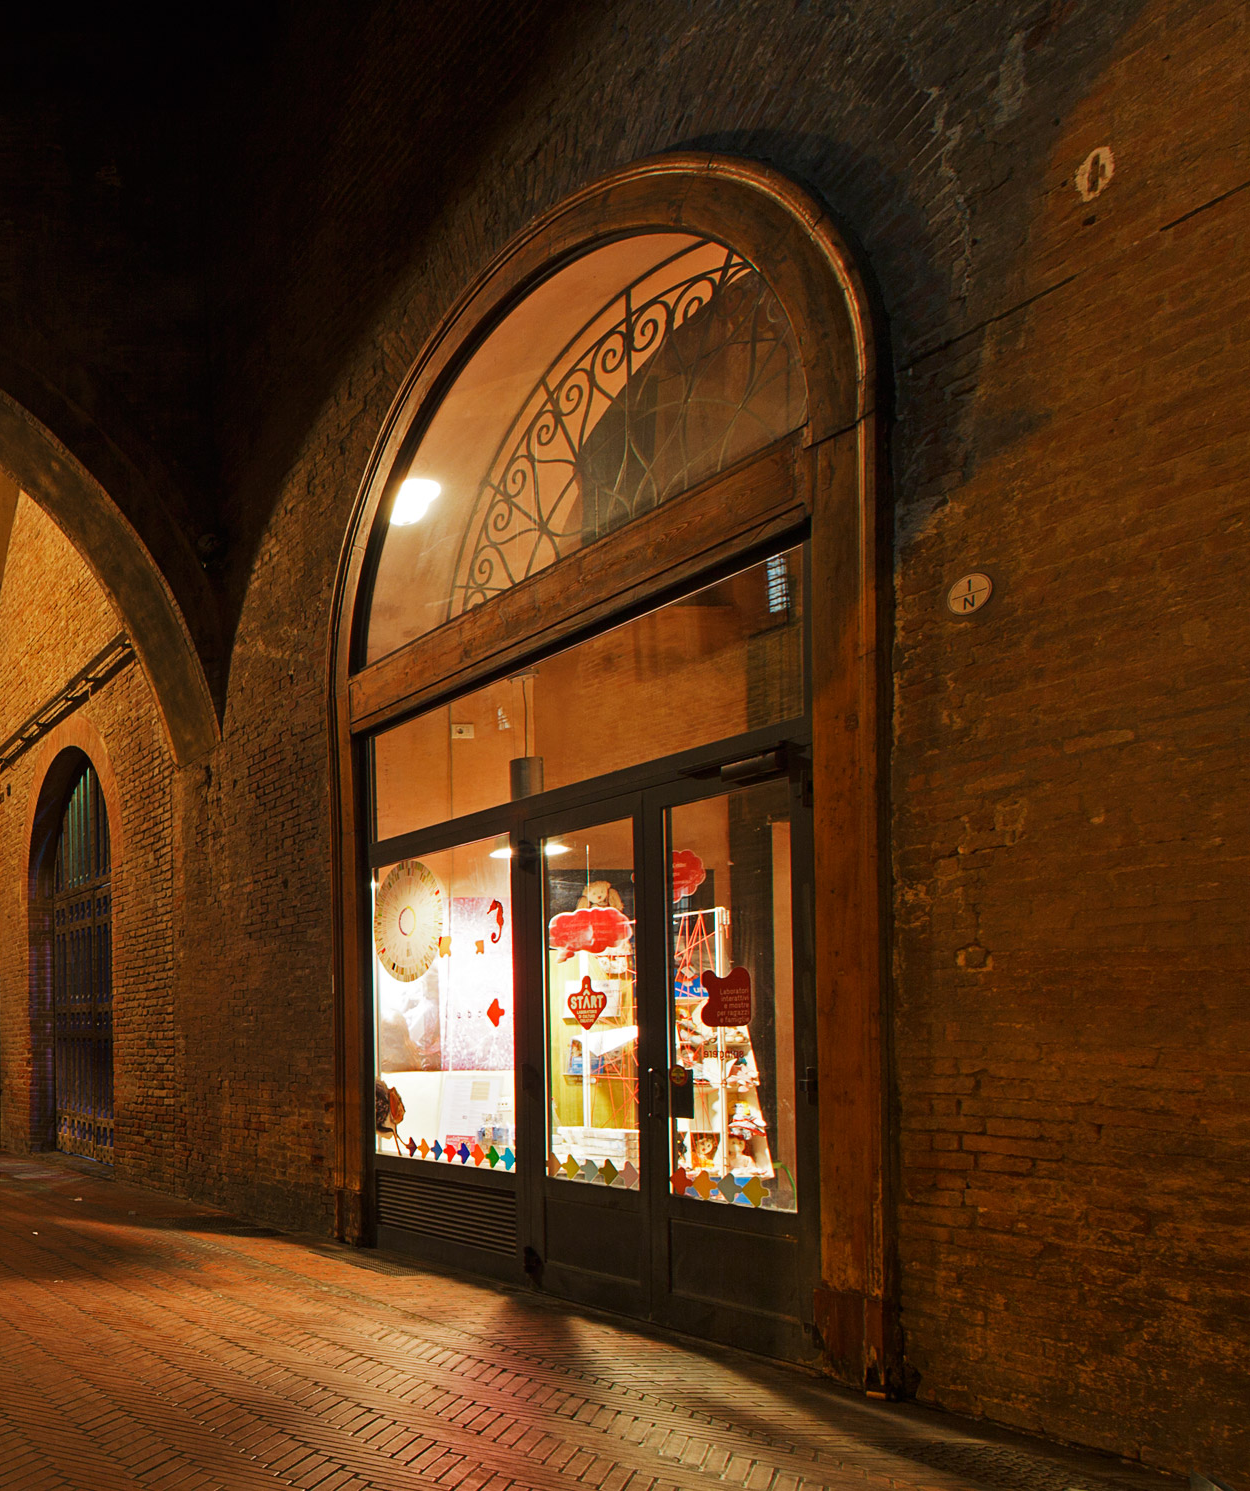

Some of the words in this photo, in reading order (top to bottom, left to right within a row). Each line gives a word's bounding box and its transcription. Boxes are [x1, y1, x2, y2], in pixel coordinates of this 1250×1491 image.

[963, 594, 976, 610] N
[719, 987, 749, 995] Laboratori
[570, 995, 604, 1009] START
[727, 1009, 750, 1017] ragazzi
[725, 1016, 750, 1024] famiglie
